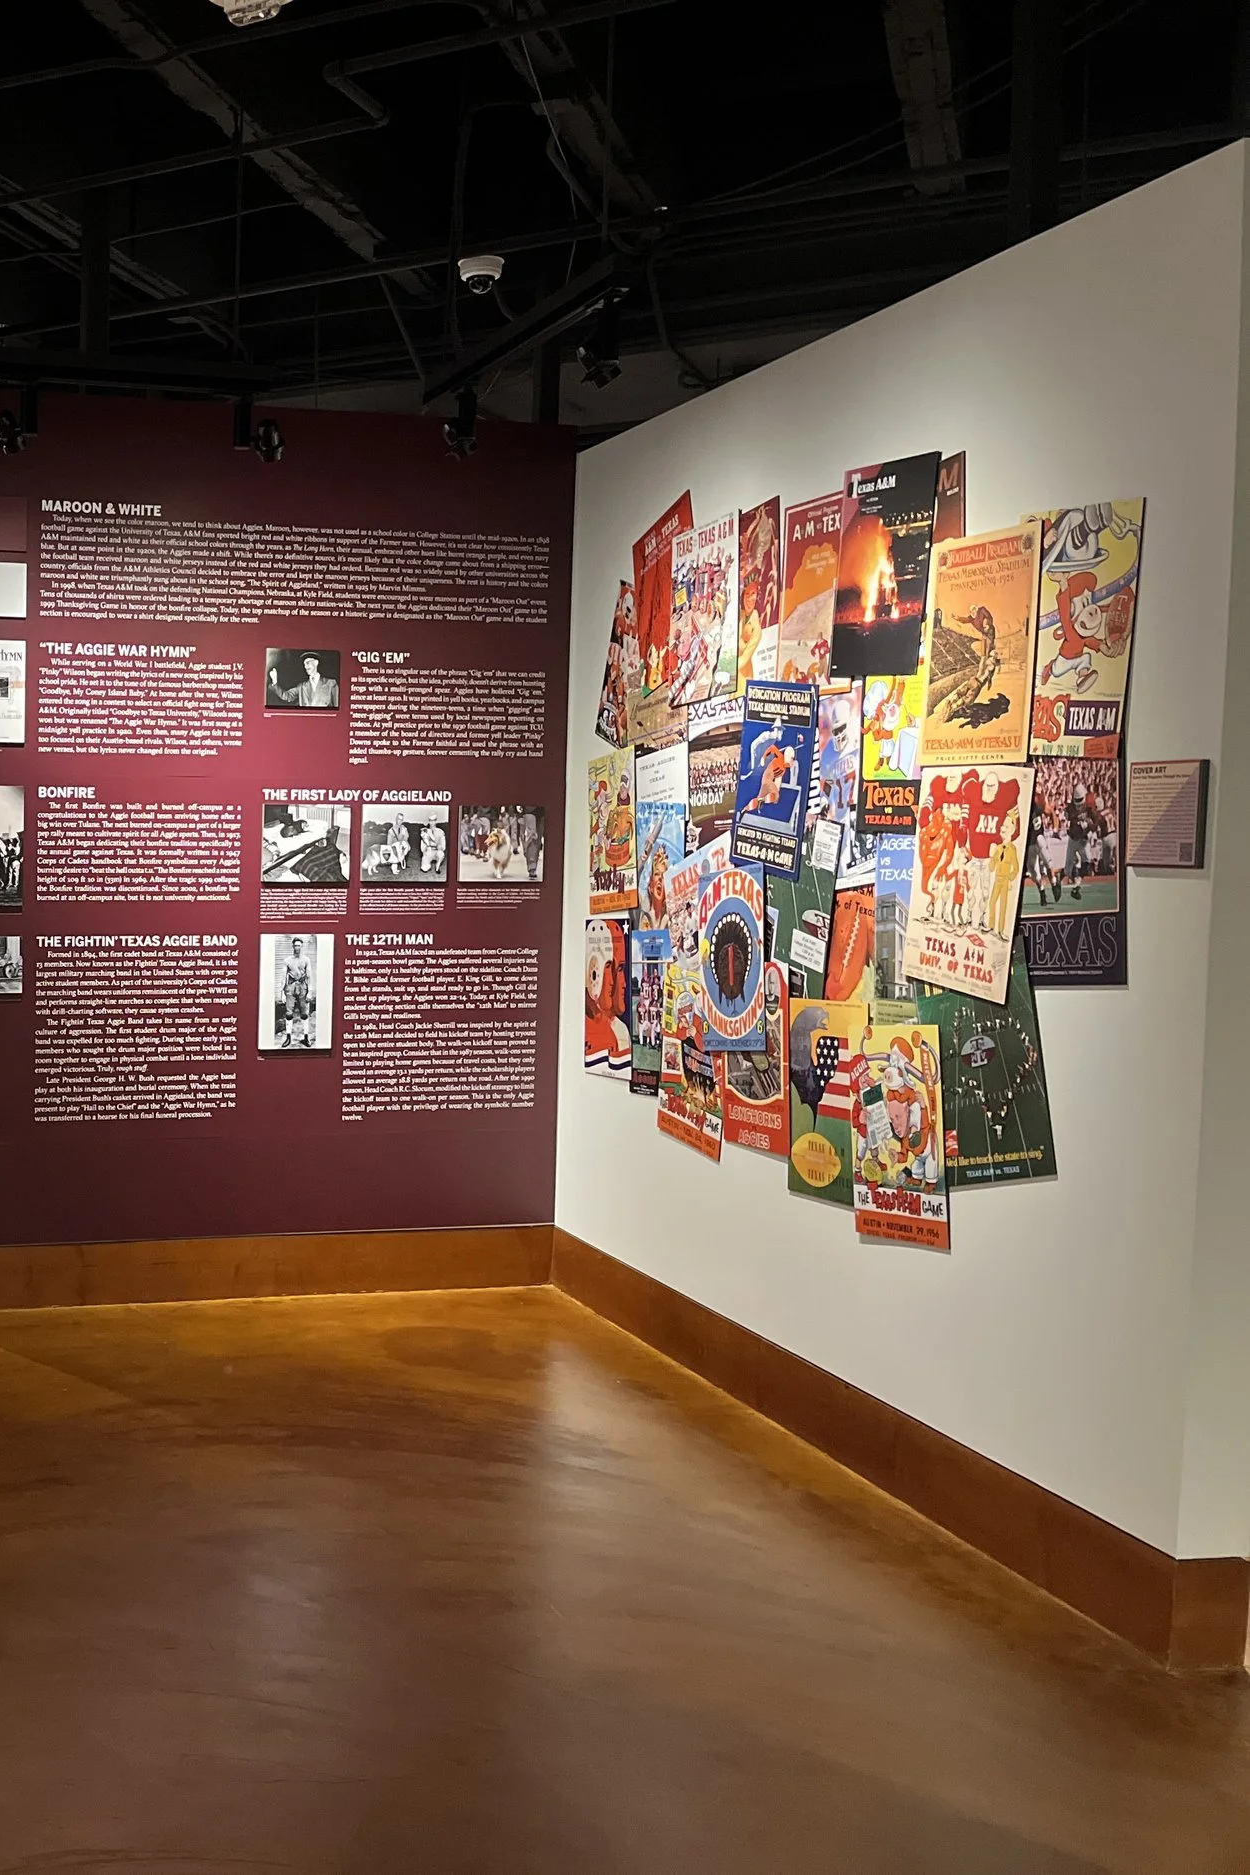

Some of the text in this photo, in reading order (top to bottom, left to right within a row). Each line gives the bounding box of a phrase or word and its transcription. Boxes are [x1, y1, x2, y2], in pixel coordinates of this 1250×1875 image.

[851, 472, 897, 499] Texas A&M
[41, 499, 162, 517] MAROON & WHITE
[676, 526, 716, 558] TEXAS TEXAS
[949, 539, 1023, 566] FOOTBALL PROGRAM
[938, 568, 961, 584] TEXAS
[997, 556, 1030, 574] STADIUM
[39, 642, 196, 658] “THE AGGIE WAR HYMN”
[351, 651, 410, 664] “GIG ‘EM”
[748, 688, 810, 704] DEDICATION PROGRAM
[749, 700, 810, 716] TEXAS MEMORIAL STADIUM
[1069, 707, 1096, 730] TEXAS
[925, 739, 955, 751] TEXAS
[982, 735, 1013, 749] TEXAS
[1133, 766, 1167, 775] COVER ART
[38, 786, 96, 799] BONFIRE
[262, 788, 452, 802] THE FIRST LADY OF AGGIELAND
[707, 789, 725, 805] DAY
[862, 782, 915, 809] Texas
[865, 815, 892, 824] TEXAS
[880, 838, 916, 851] AGGIES
[671, 863, 700, 896] TEXAS
[880, 869, 914, 880] TEXAS
[844, 899, 875, 918] of Texas
[35, 935, 238, 947] THE FIGHTIN’ TEXAS AGGIE BAND
[344, 933, 433, 946] THE 12TH MAN
[925, 936, 956, 959] TEXAS
[47, 950, 72, 958] Formed
[72, 950, 80, 958] in
[98, 950, 109, 958] the
[109, 950, 123, 958] first
[123, 950, 141, 958] cadet
[164, 949, 183, 957] Texas
[183, 949, 201, 957] A&M
[201, 949, 231, 957] consisted
[231, 949, 239, 957] of
[920, 954, 942, 971] UNIV.
[947, 960, 959, 973] OF
[964, 964, 994, 985] TEXAS
[701, 983, 764, 1040] THANKSGIVING
[728, 1104, 783, 1130] LONGHORNS
[737, 1127, 770, 1149] AGGIES
[966, 1165, 1020, 1178] TEXAS TEXAS
[857, 1191, 870, 1205] THE
[922, 1200, 944, 1217] GAME
